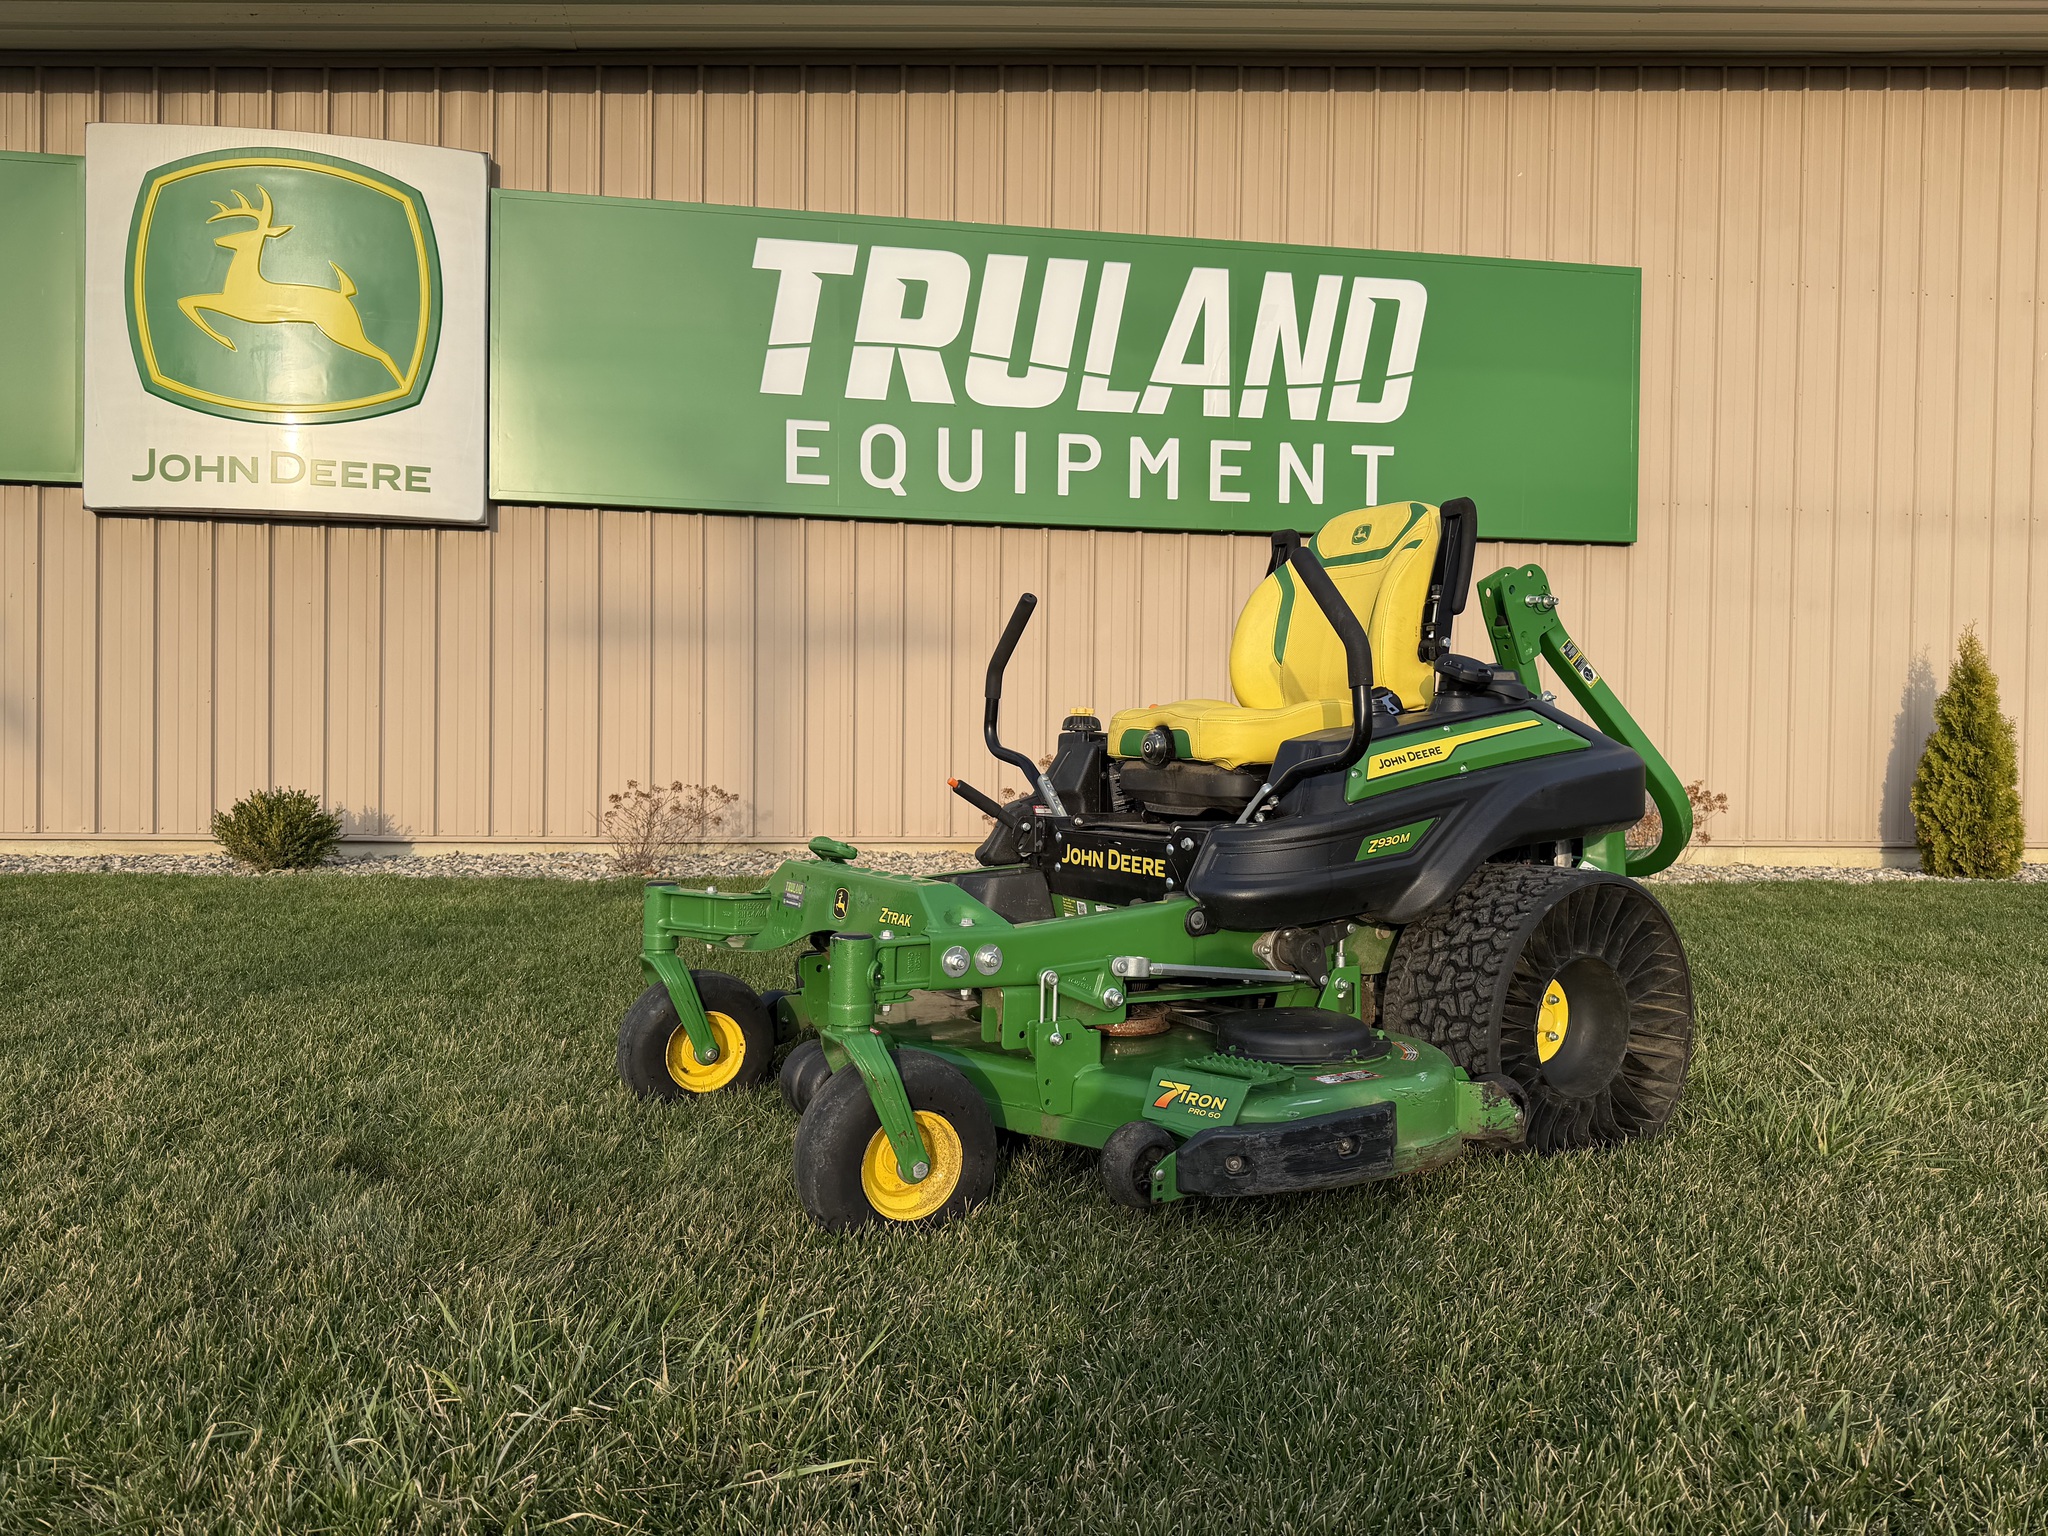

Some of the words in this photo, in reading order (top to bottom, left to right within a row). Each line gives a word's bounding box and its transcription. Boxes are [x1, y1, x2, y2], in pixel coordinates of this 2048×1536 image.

[751, 236, 1429, 424] TRULAND
[132, 448, 259, 484] JOHN
[270, 450, 432, 493] DEERE
[785, 418, 1396, 506] EQUIPMENT
[1379, 755, 1407, 770] JOHN
[1407, 746, 1443, 760] DEERE
[1367, 832, 1411, 854] Z930M
[1061, 843, 1104, 869] JOHN
[1107, 848, 1166, 878] DEERE
[879, 907, 913, 928] ZTRAK
[1188, 1107, 1207, 1117] PRO
[1207, 1111, 1221, 1119] 60
